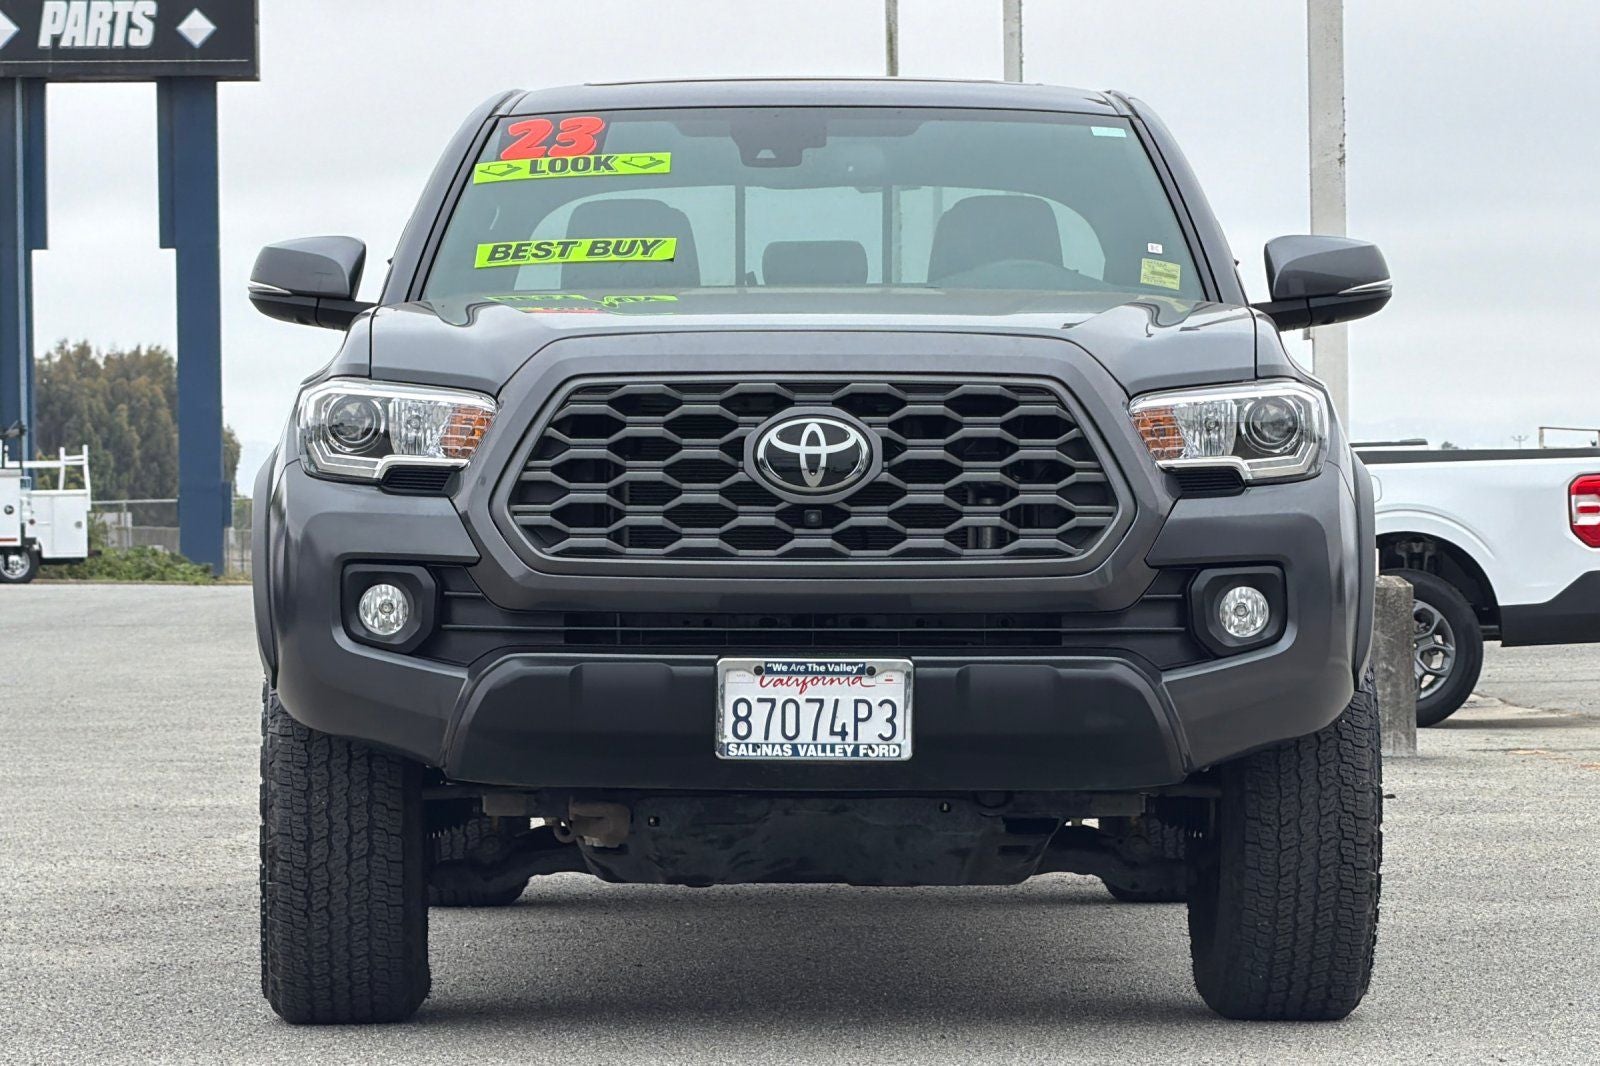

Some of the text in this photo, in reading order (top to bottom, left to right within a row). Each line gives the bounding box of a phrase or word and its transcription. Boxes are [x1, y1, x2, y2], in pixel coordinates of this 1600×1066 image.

[38, 0, 157, 48] PARTS
[501, 116, 606, 160] 23
[529, 155, 618, 175] LOOK
[487, 239, 667, 262] BEST BUY
[789, 664, 805, 672] Are
[807, 663, 826, 672] The
[732, 697, 898, 741] 87074P3
[728, 744, 900, 757] SALINAS VALLEY FORD
